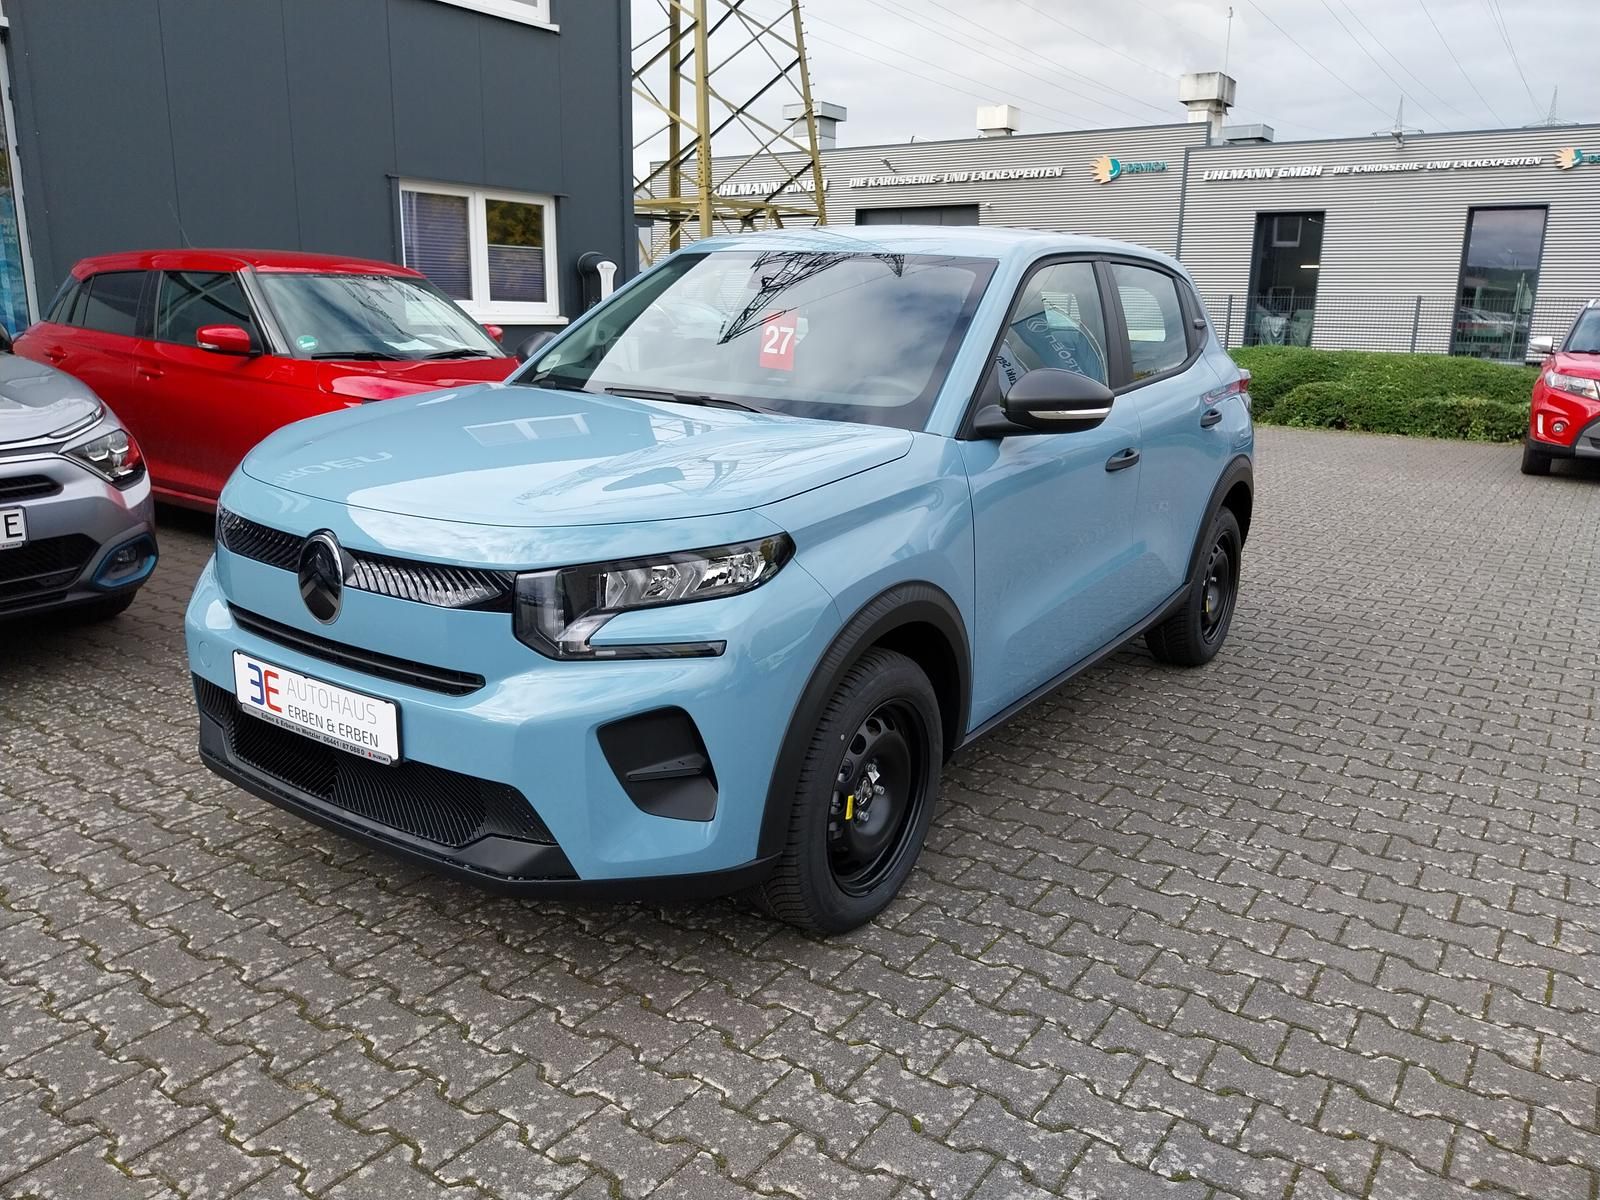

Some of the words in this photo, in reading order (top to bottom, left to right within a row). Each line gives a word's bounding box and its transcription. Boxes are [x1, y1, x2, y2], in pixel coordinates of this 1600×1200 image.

[783, 178, 829, 194] GMB
[849, 177, 867, 188] DIE
[944, 171, 969, 184] UND
[971, 167, 1063, 181] LACKEXPERTEN
[1202, 168, 1274, 181] UHLMANN
[1277, 165, 1323, 177] GMBH
[1333, 165, 1350, 174] DIE
[1426, 160, 1451, 170] UND
[1453, 156, 1542, 169] LACKEXPERTEN
[763, 325, 794, 355] 27
[4, 513, 23, 538] E
[286, 677, 377, 725] AUTOHAUS
[261, 712, 275, 721] Erben
[281, 720, 295, 730] Erben
[301, 728, 321, 740] Wetzlar
[288, 704, 324, 729] ERBEN
[326, 718, 336, 734] &
[338, 722, 378, 748] ERBEN
